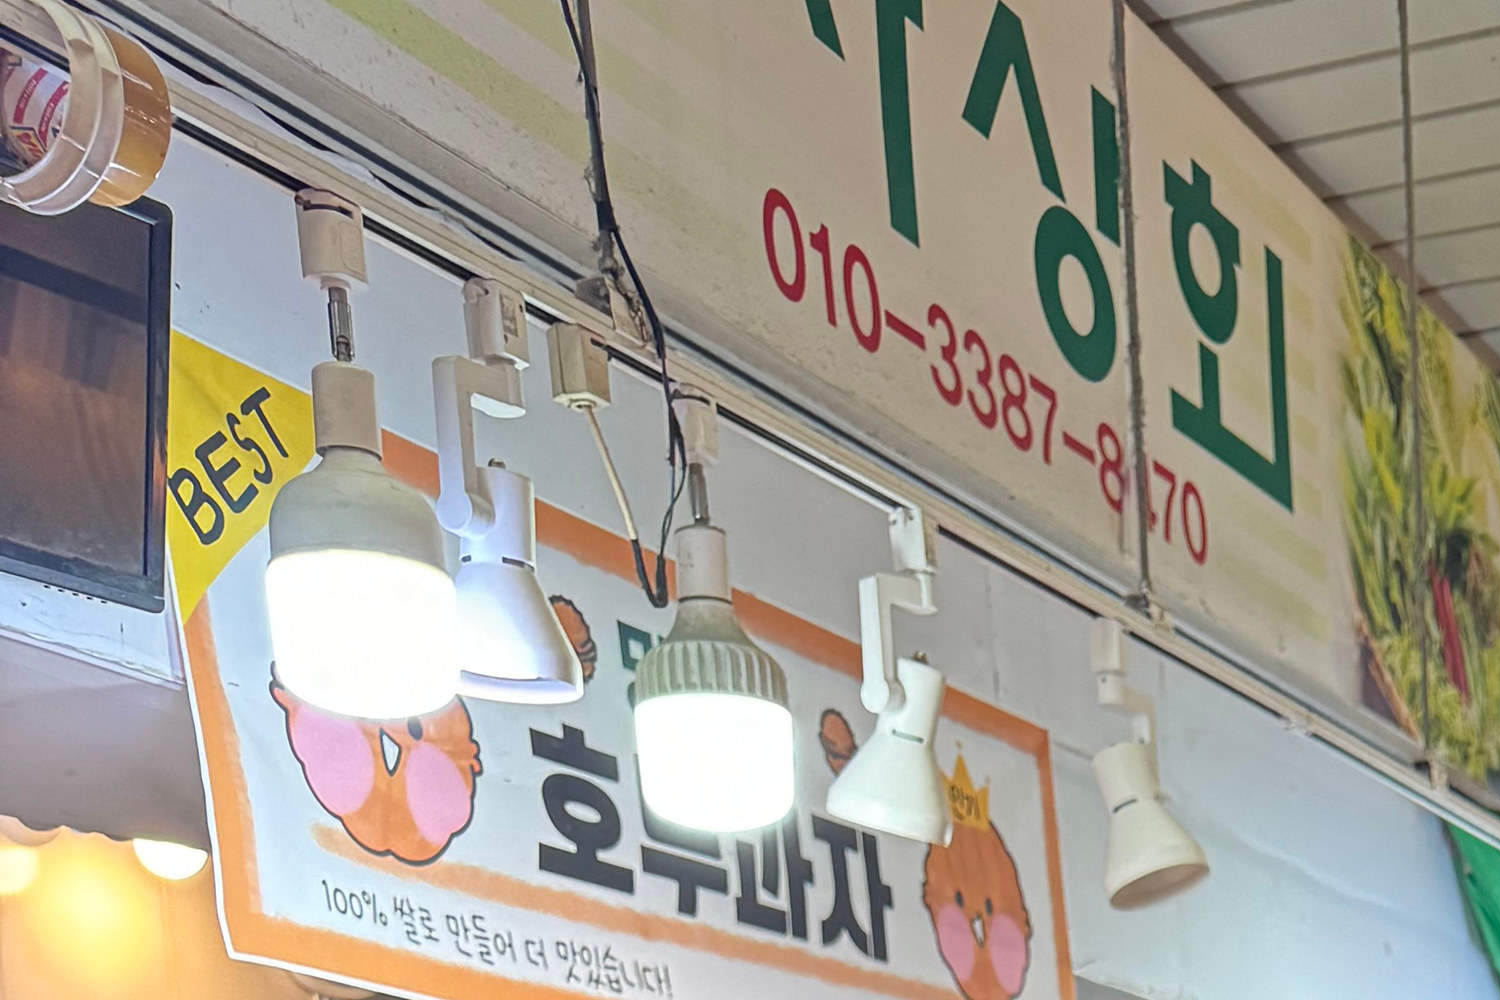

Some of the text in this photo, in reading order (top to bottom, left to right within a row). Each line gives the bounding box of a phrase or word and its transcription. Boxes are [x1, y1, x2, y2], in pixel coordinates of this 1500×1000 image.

[168, 386, 290, 546] BEST
[321, 879, 673, 999] 100% 쌀로 만들어 더 맛있습니다!
